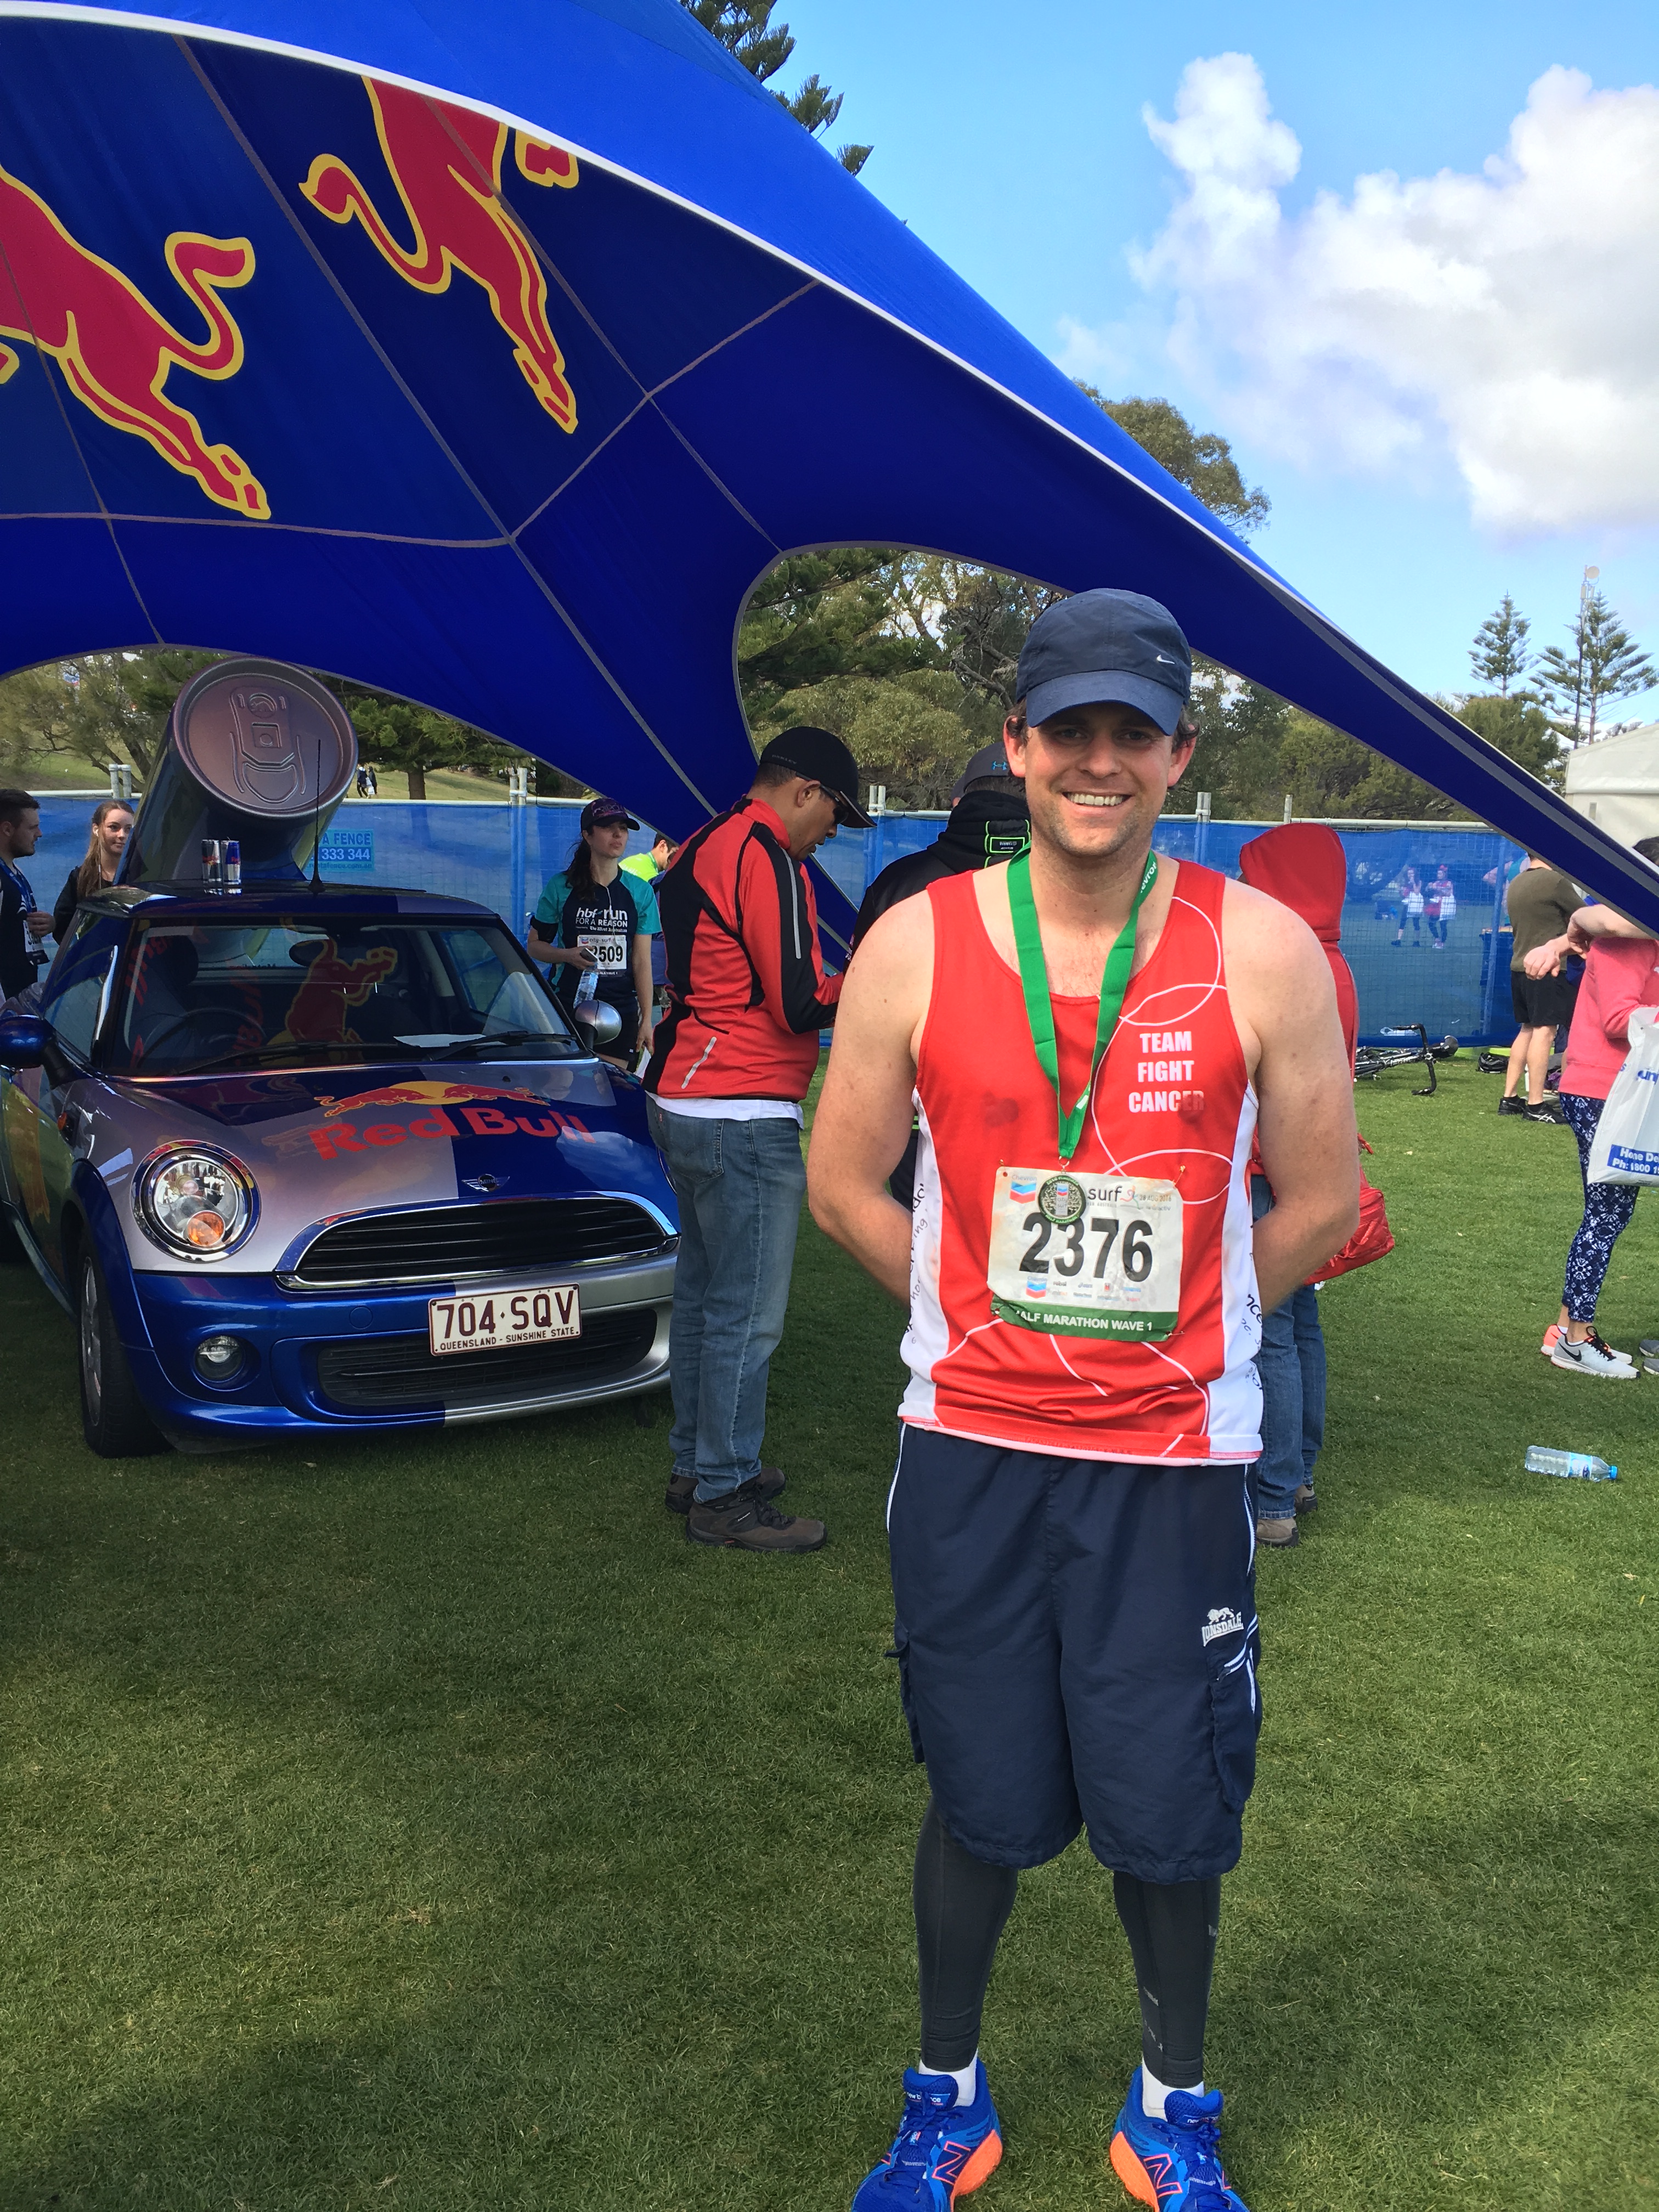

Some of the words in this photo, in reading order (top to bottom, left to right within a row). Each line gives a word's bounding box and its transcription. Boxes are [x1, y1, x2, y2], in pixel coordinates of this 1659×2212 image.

[334, 833, 371, 845] FENCE
[321, 848, 344, 860] 333
[348, 848, 370, 860] 344
[577, 907, 597, 918] hbf
[603, 909, 628, 920] run
[598, 919, 628, 927] REASON
[1139, 1031, 1192, 1053] TEAM
[1138, 1060, 1194, 1082] FIGHT
[1128, 1090, 1204, 1113] CANCER
[308, 1108, 460, 1160] Red
[459, 1107, 596, 1144] Bull
[1612, 1158, 1629, 1170] Ph:
[1630, 1163, 1650, 1173] 1800
[1087, 1184, 1122, 1202] surf
[1019, 1211, 1153, 1283] 2376
[437, 1300, 496, 1339] 704
[511, 1290, 574, 1330] SQV
[1043, 1313, 1109, 1329] MARATHON
[1111, 1319, 1144, 1331] WAVE
[1147, 1322, 1152, 1331] 1
[440, 1336, 496, 1351] QUEENSLAND
[506, 1330, 547, 1343] SUNSHINE
[551, 1327, 575, 1337] STATE
[1201, 1612, 1244, 1646] LONSDALE
